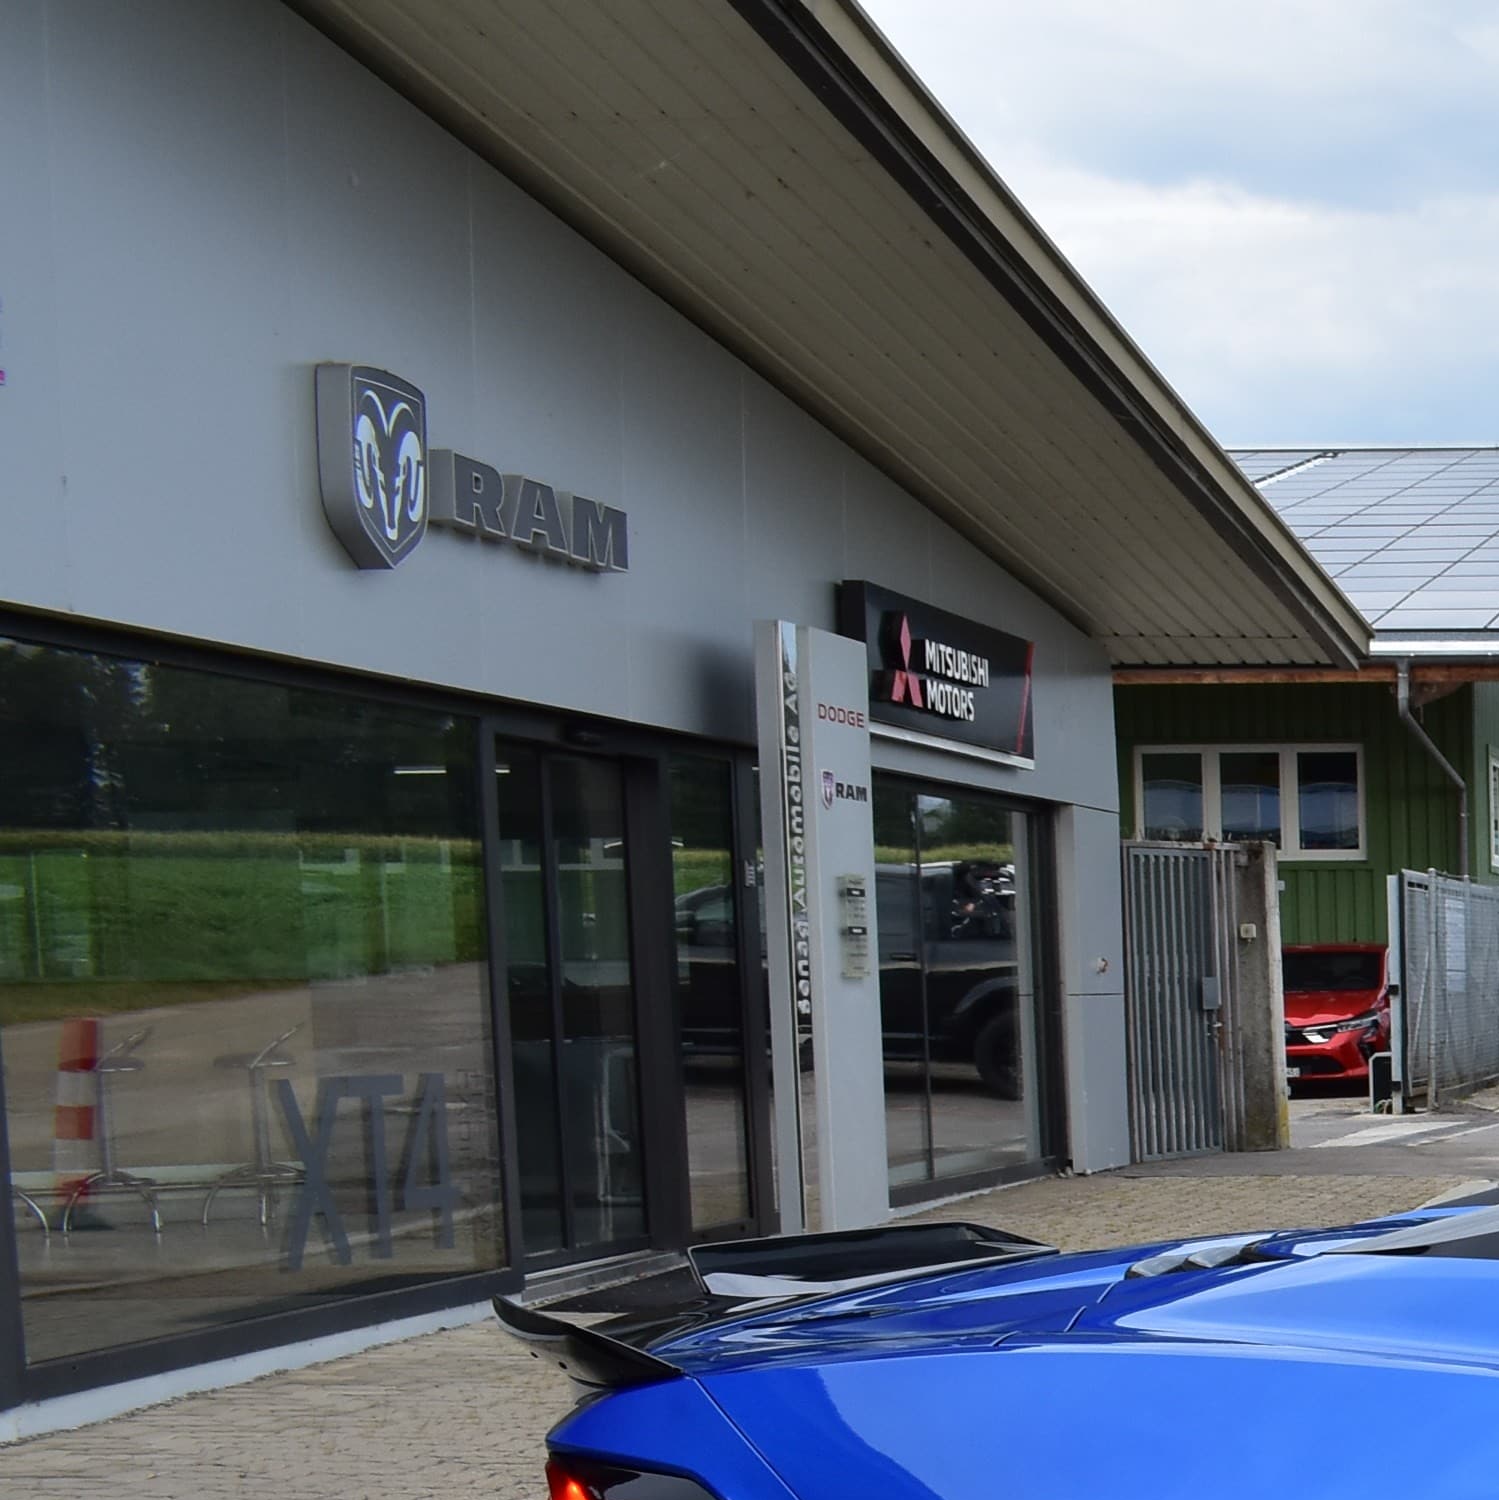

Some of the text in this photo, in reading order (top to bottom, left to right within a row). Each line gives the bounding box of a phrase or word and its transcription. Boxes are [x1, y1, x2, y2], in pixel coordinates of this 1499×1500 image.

[448, 451, 630, 573] RAM
[924, 639, 990, 688] MITSUBISHI
[817, 703, 865, 728] DODGE
[926, 678, 975, 722] MOTORS
[835, 782, 868, 802] RAM
[785, 724, 809, 912] Automobile
[278, 1072, 461, 1273] XT4
